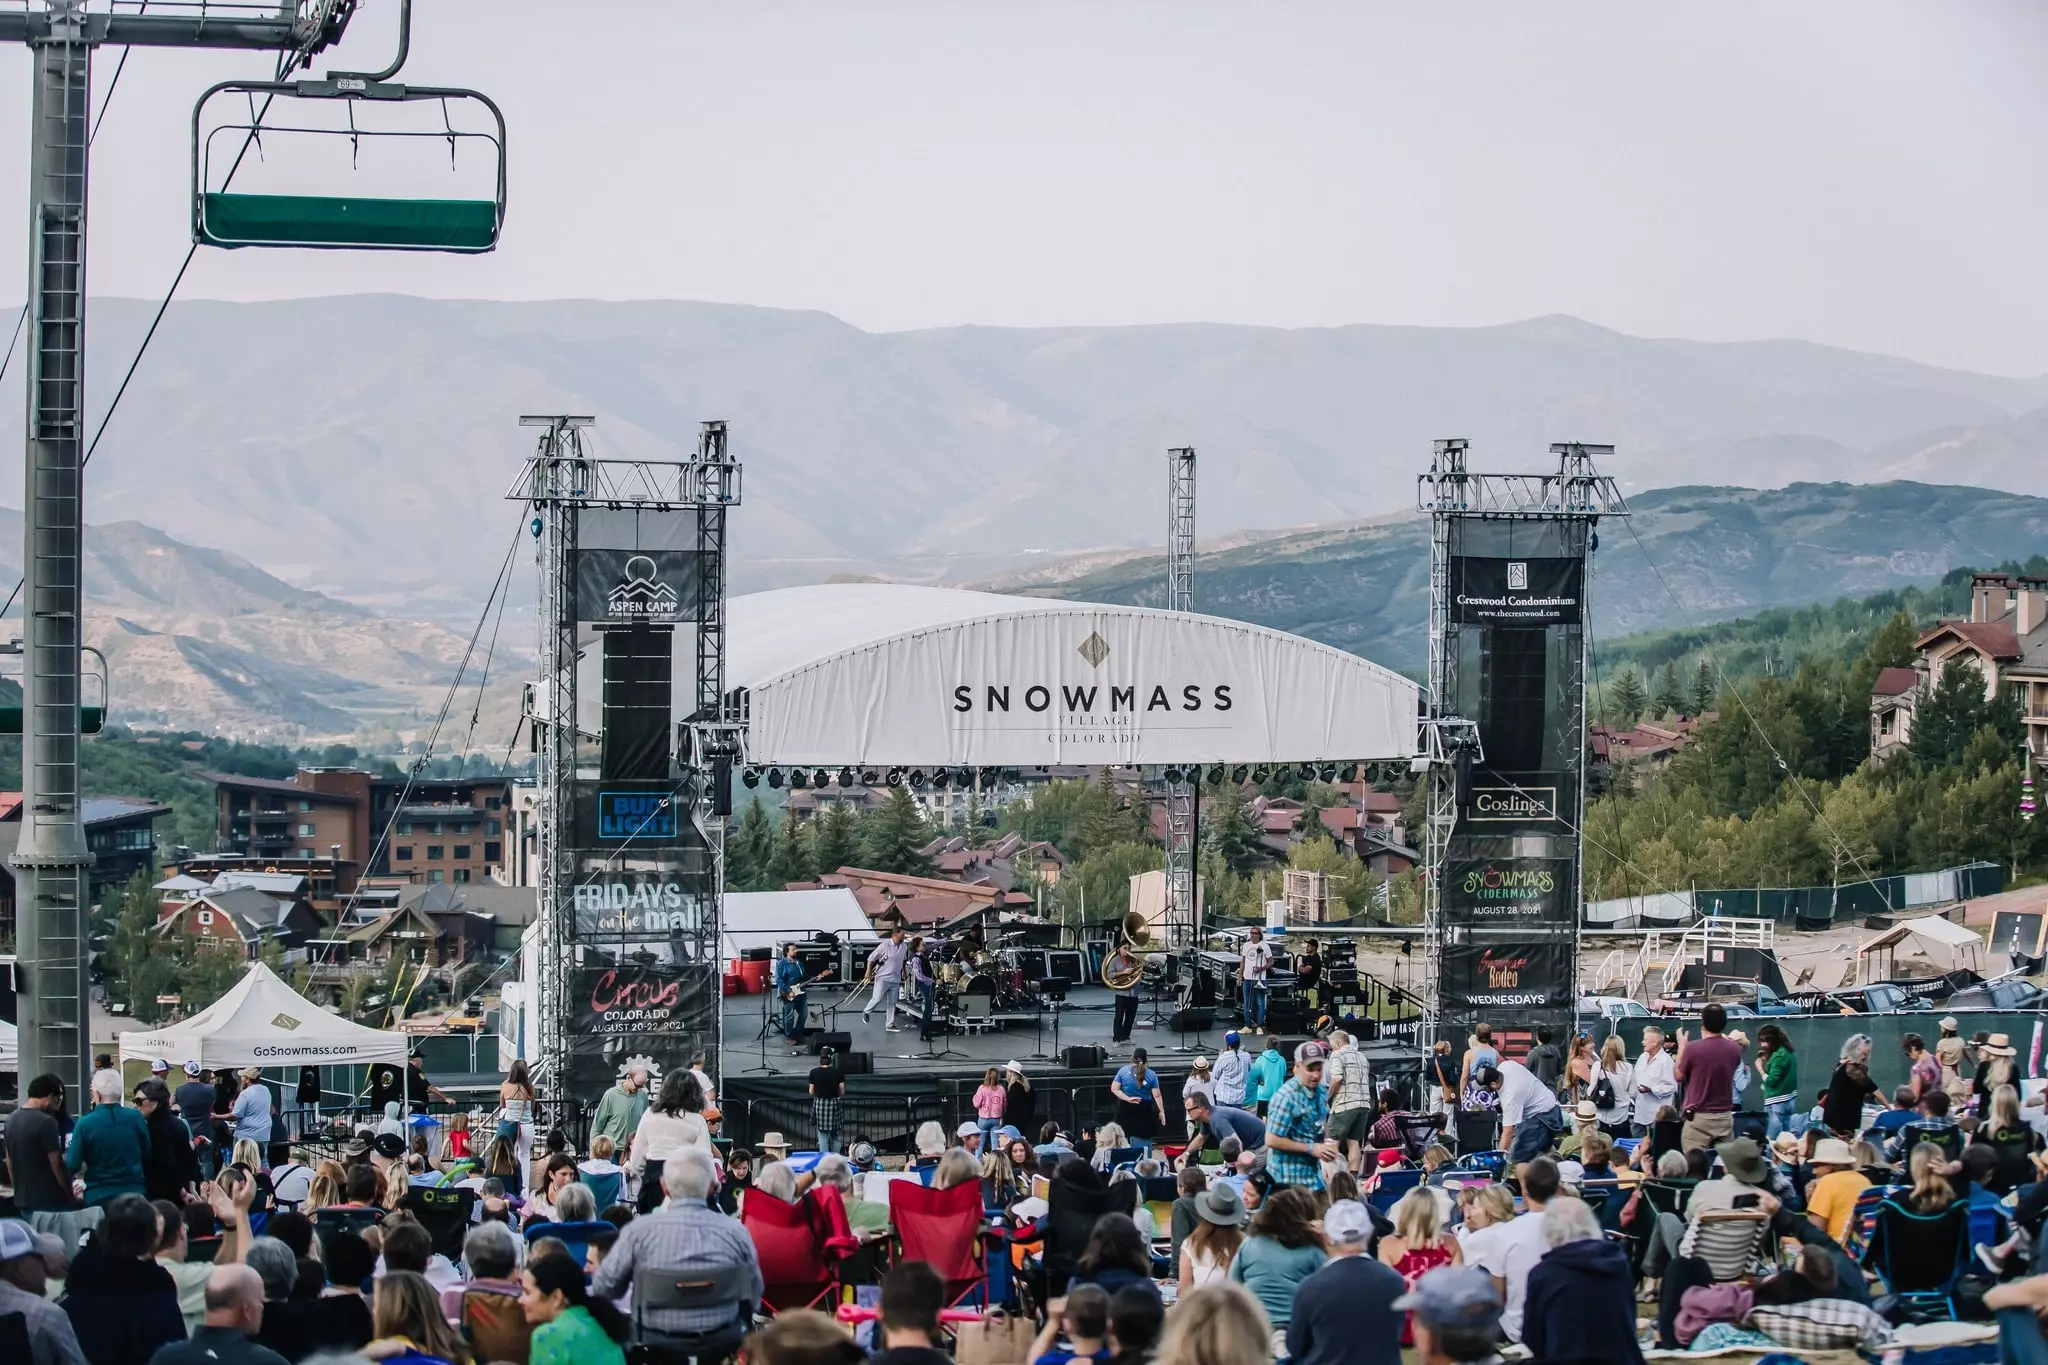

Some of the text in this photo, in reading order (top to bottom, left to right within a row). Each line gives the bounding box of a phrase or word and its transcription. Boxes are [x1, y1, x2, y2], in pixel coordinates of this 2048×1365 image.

[1457, 594, 1576, 606] Crestwood Condominiums
[608, 601, 678, 612] ASPEN CAMP
[1477, 609, 1561, 617] www.thecrestwood.com
[953, 685, 1233, 713] SNOWMASS
[1059, 715, 1131, 726] VILLAGE
[1048, 733, 1141, 744] COLORADO
[614, 798, 668, 815] BUD
[1477, 794, 1545, 817] Goslings
[604, 816, 670, 833] LIGHT
[1464, 868, 1554, 893] SNOWMASS
[574, 883, 681, 910] FRIDAYS
[1477, 888, 1538, 899] CIDERMASS
[600, 900, 702, 931] on the mall
[1473, 906, 1505, 915] AUGUST
[1522, 906, 1541, 915] 2021
[1488, 966, 1518, 988] Rodeo
[591, 969, 681, 1012] Circus
[1466, 995, 1545, 1005] WEDNESDAYS
[604, 1009, 670, 1021] COLORADO
[591, 1023, 630, 1033] AUGUST
[664, 1021, 685, 1030] 2021
[253, 1046, 357, 1057] GoSnowmass.com
